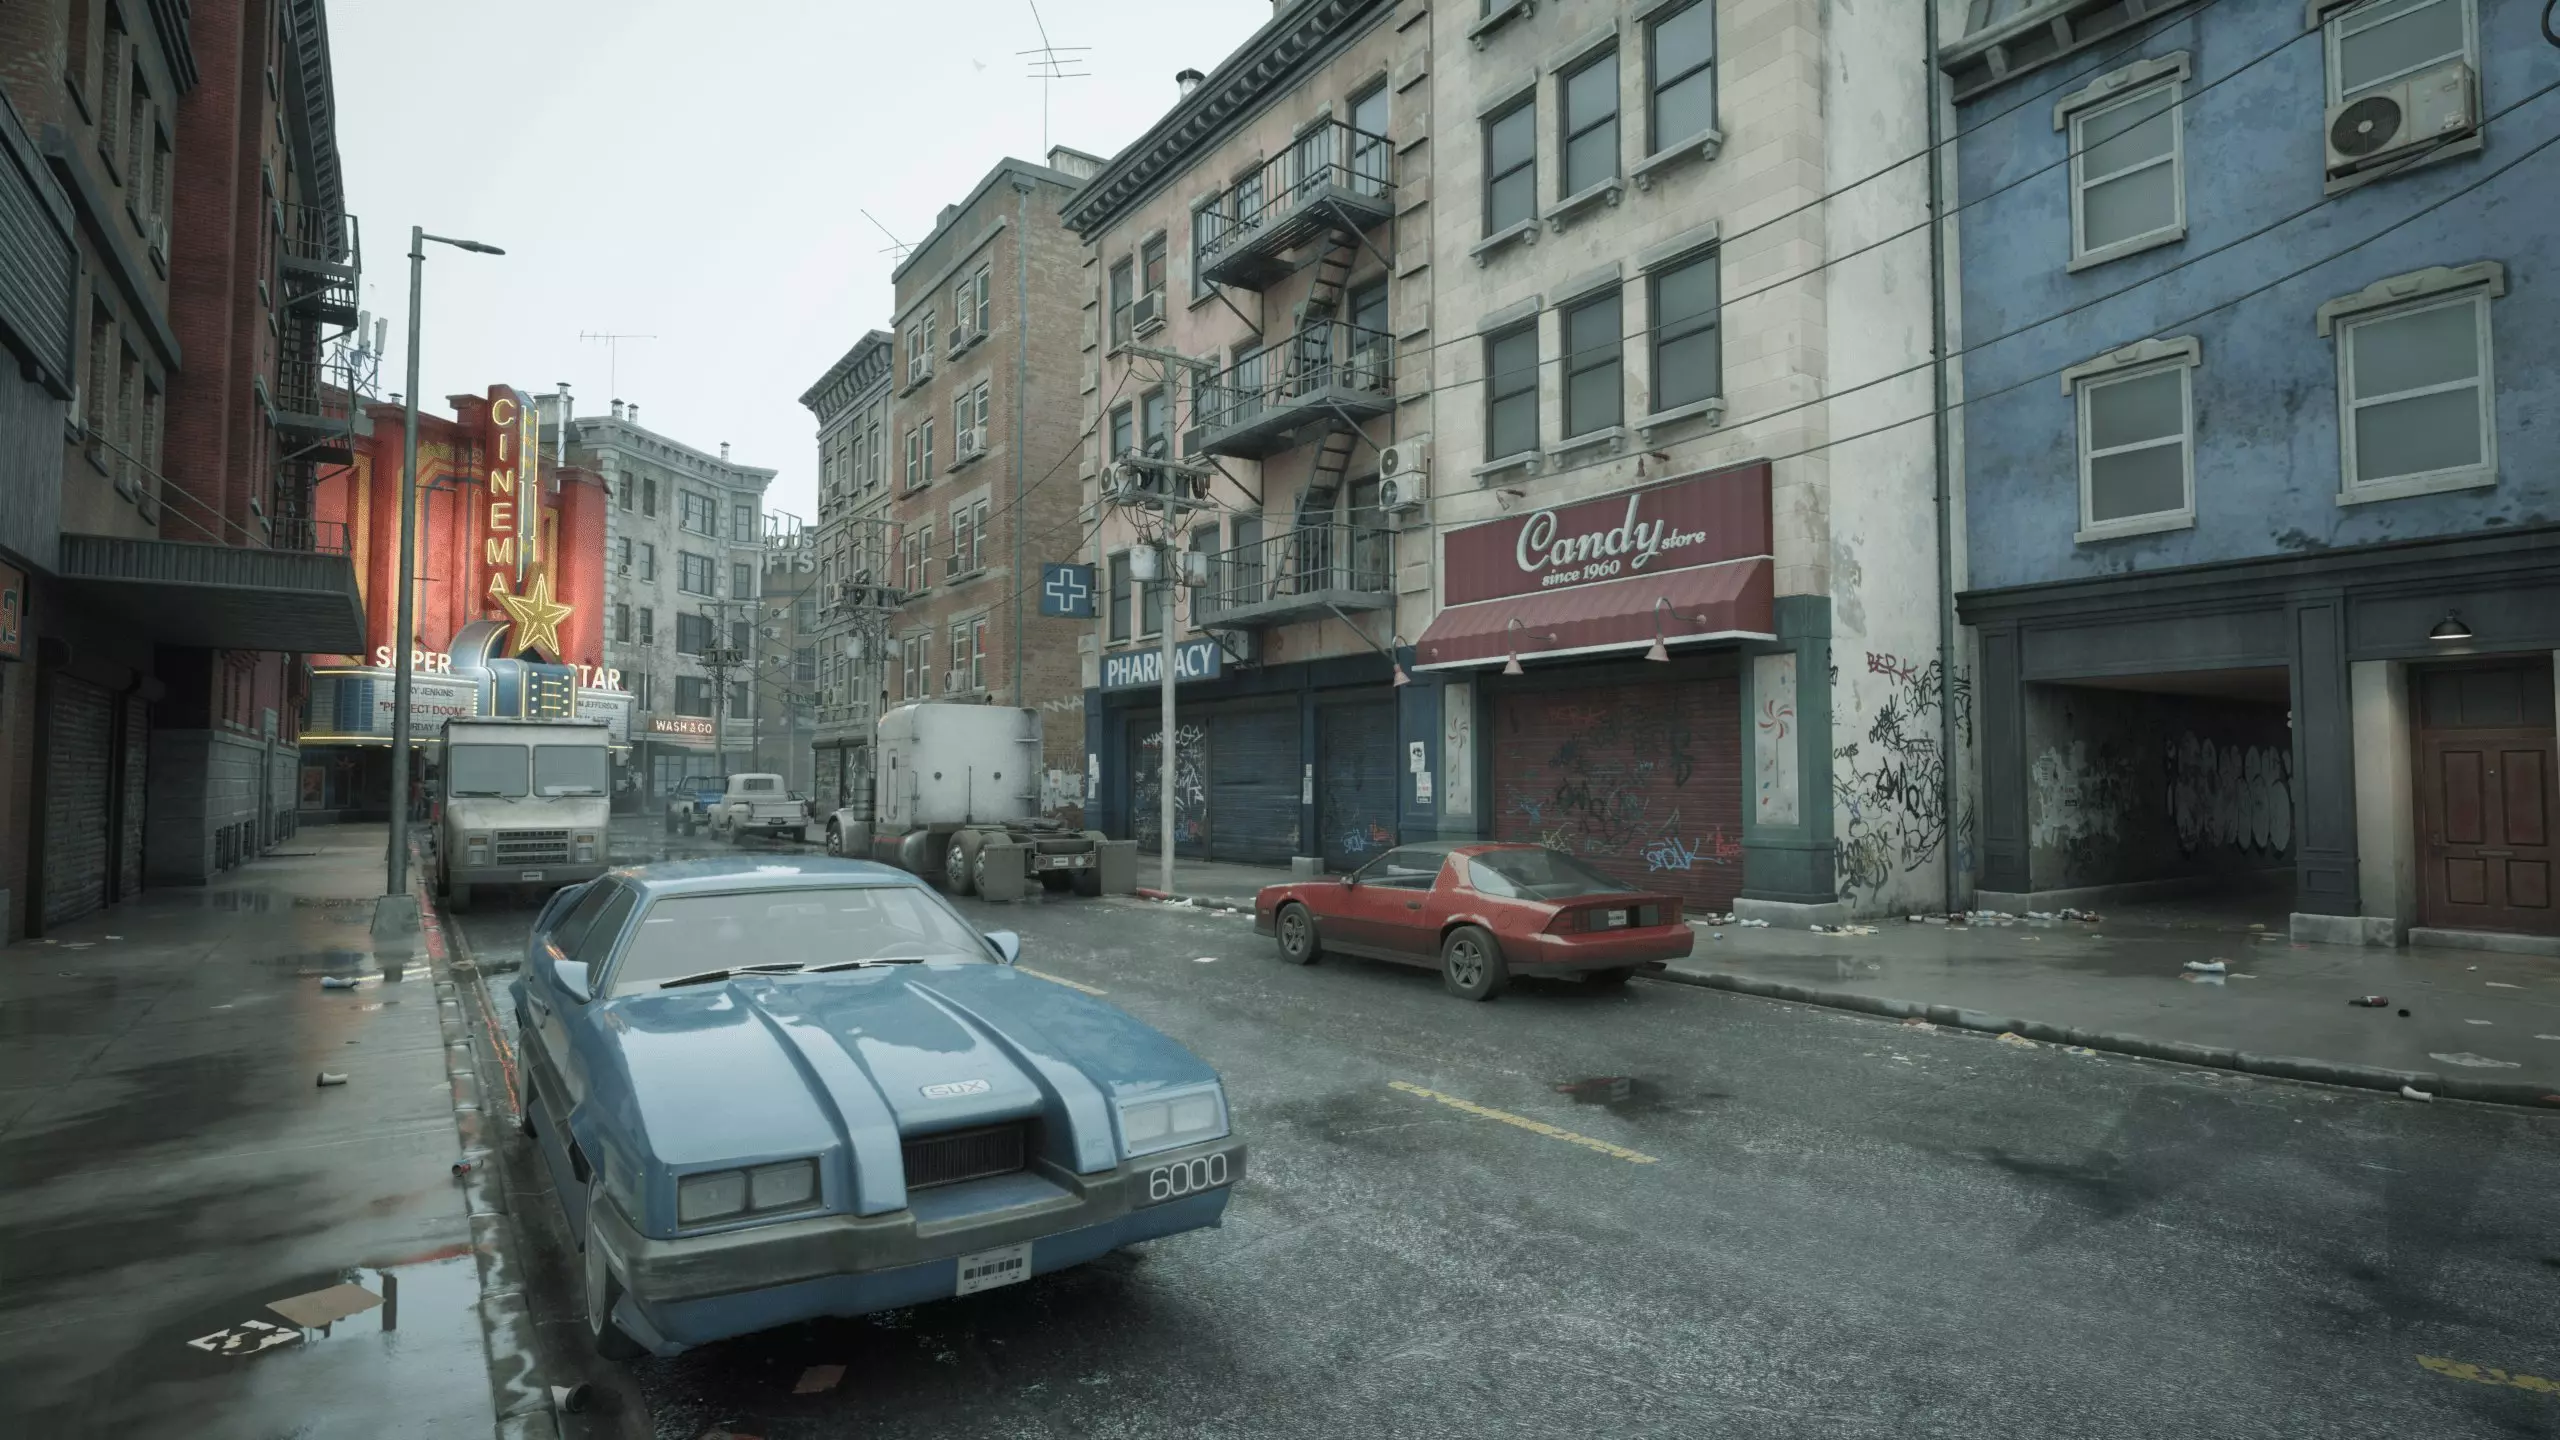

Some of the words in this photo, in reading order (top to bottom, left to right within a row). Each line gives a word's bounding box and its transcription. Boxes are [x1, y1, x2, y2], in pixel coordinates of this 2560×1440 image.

[487, 398, 516, 594] CINEMA
[1516, 493, 1664, 573] Candy
[1661, 528, 1706, 550] store
[758, 551, 815, 575] FTS
[1542, 568, 1580, 586] since
[1583, 560, 1621, 580] 1960
[376, 645, 452, 676] SPER
[420, 687, 454, 698] JENKINS
[655, 719, 687, 733] WASH
[697, 723, 713, 734] GO
[929, 1080, 984, 1096] SUX
[1149, 1152, 1228, 1201] 6000
